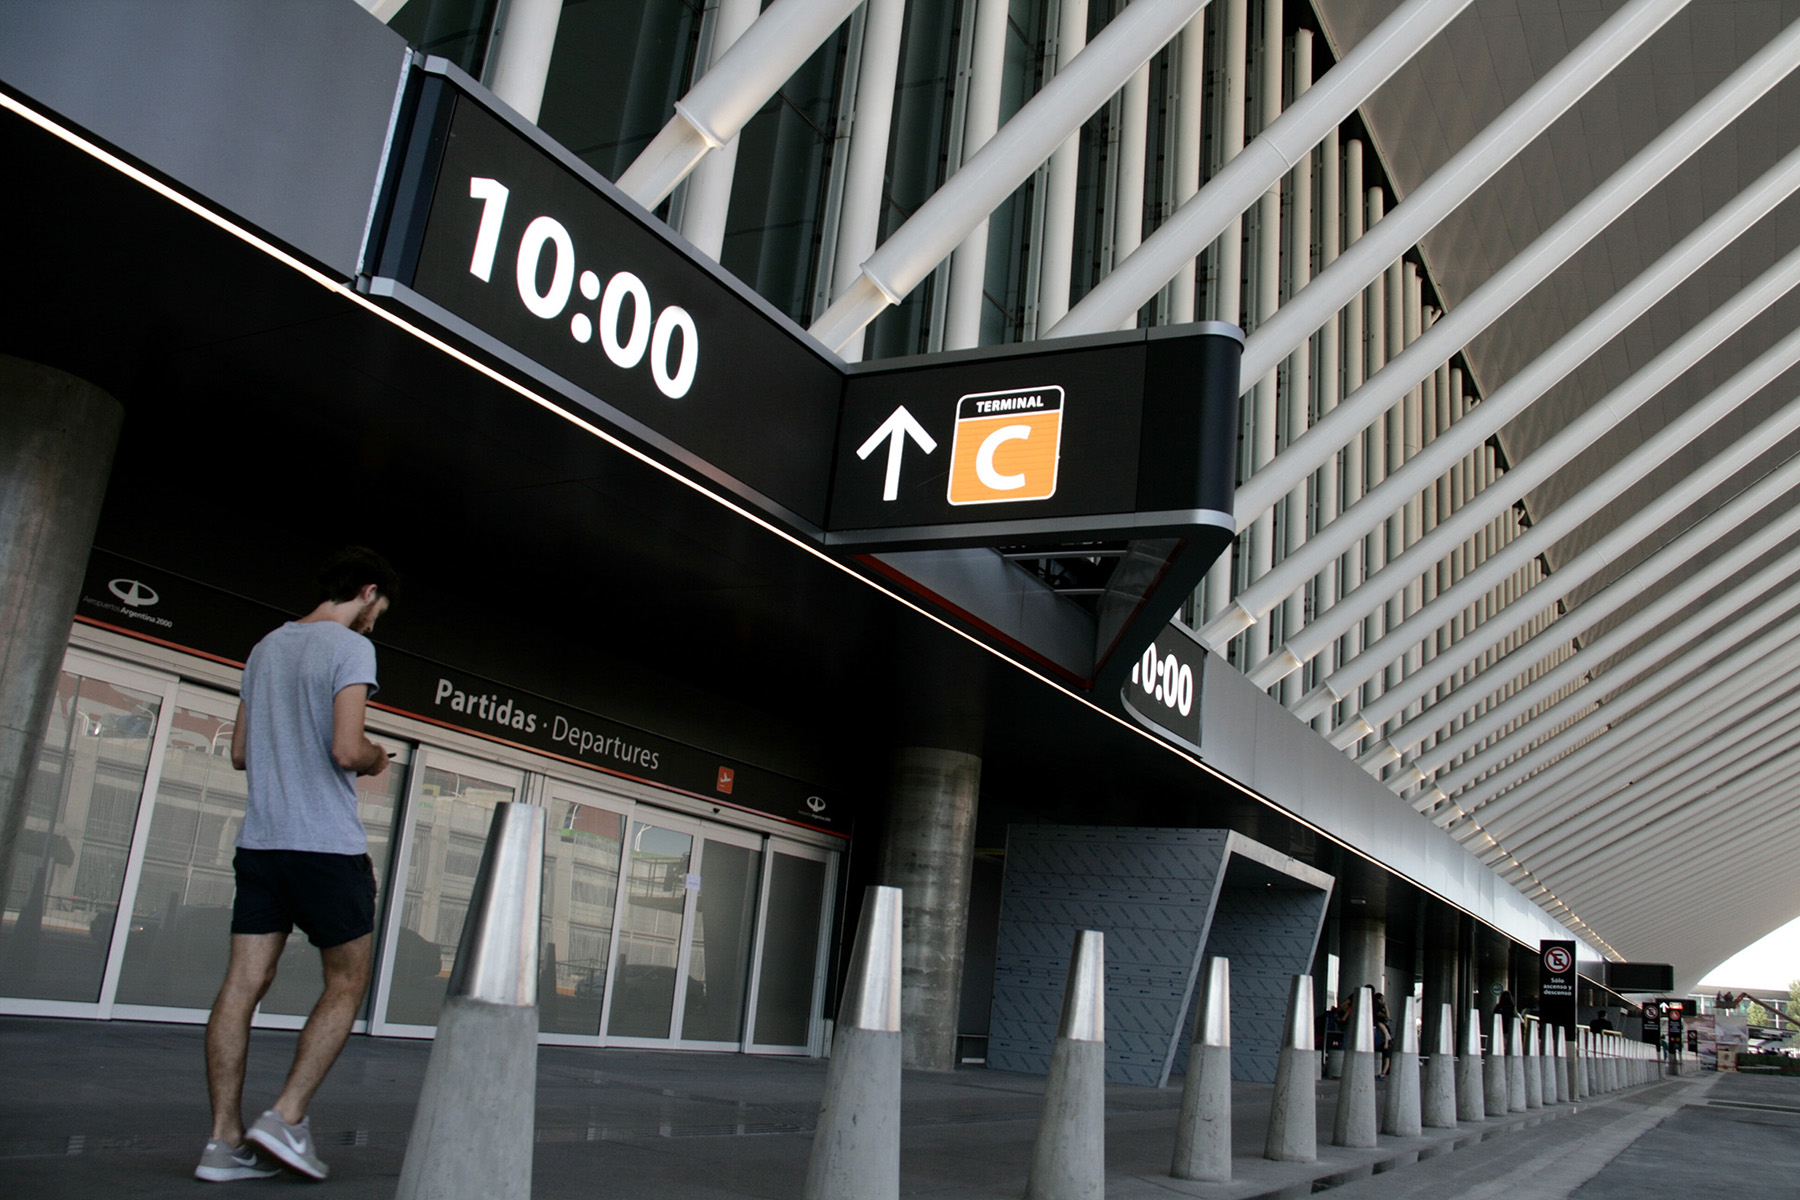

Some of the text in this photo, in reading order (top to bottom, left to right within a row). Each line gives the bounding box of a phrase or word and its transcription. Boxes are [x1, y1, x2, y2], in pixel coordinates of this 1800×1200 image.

[469, 177, 699, 399] 10:00
[976, 395, 1044, 413] TERMINAL
[975, 424, 1032, 490] C
[120, 606, 156, 624] Argentina
[155, 616, 173, 629] 2000
[434, 678, 660, 770] Partidas Departures
